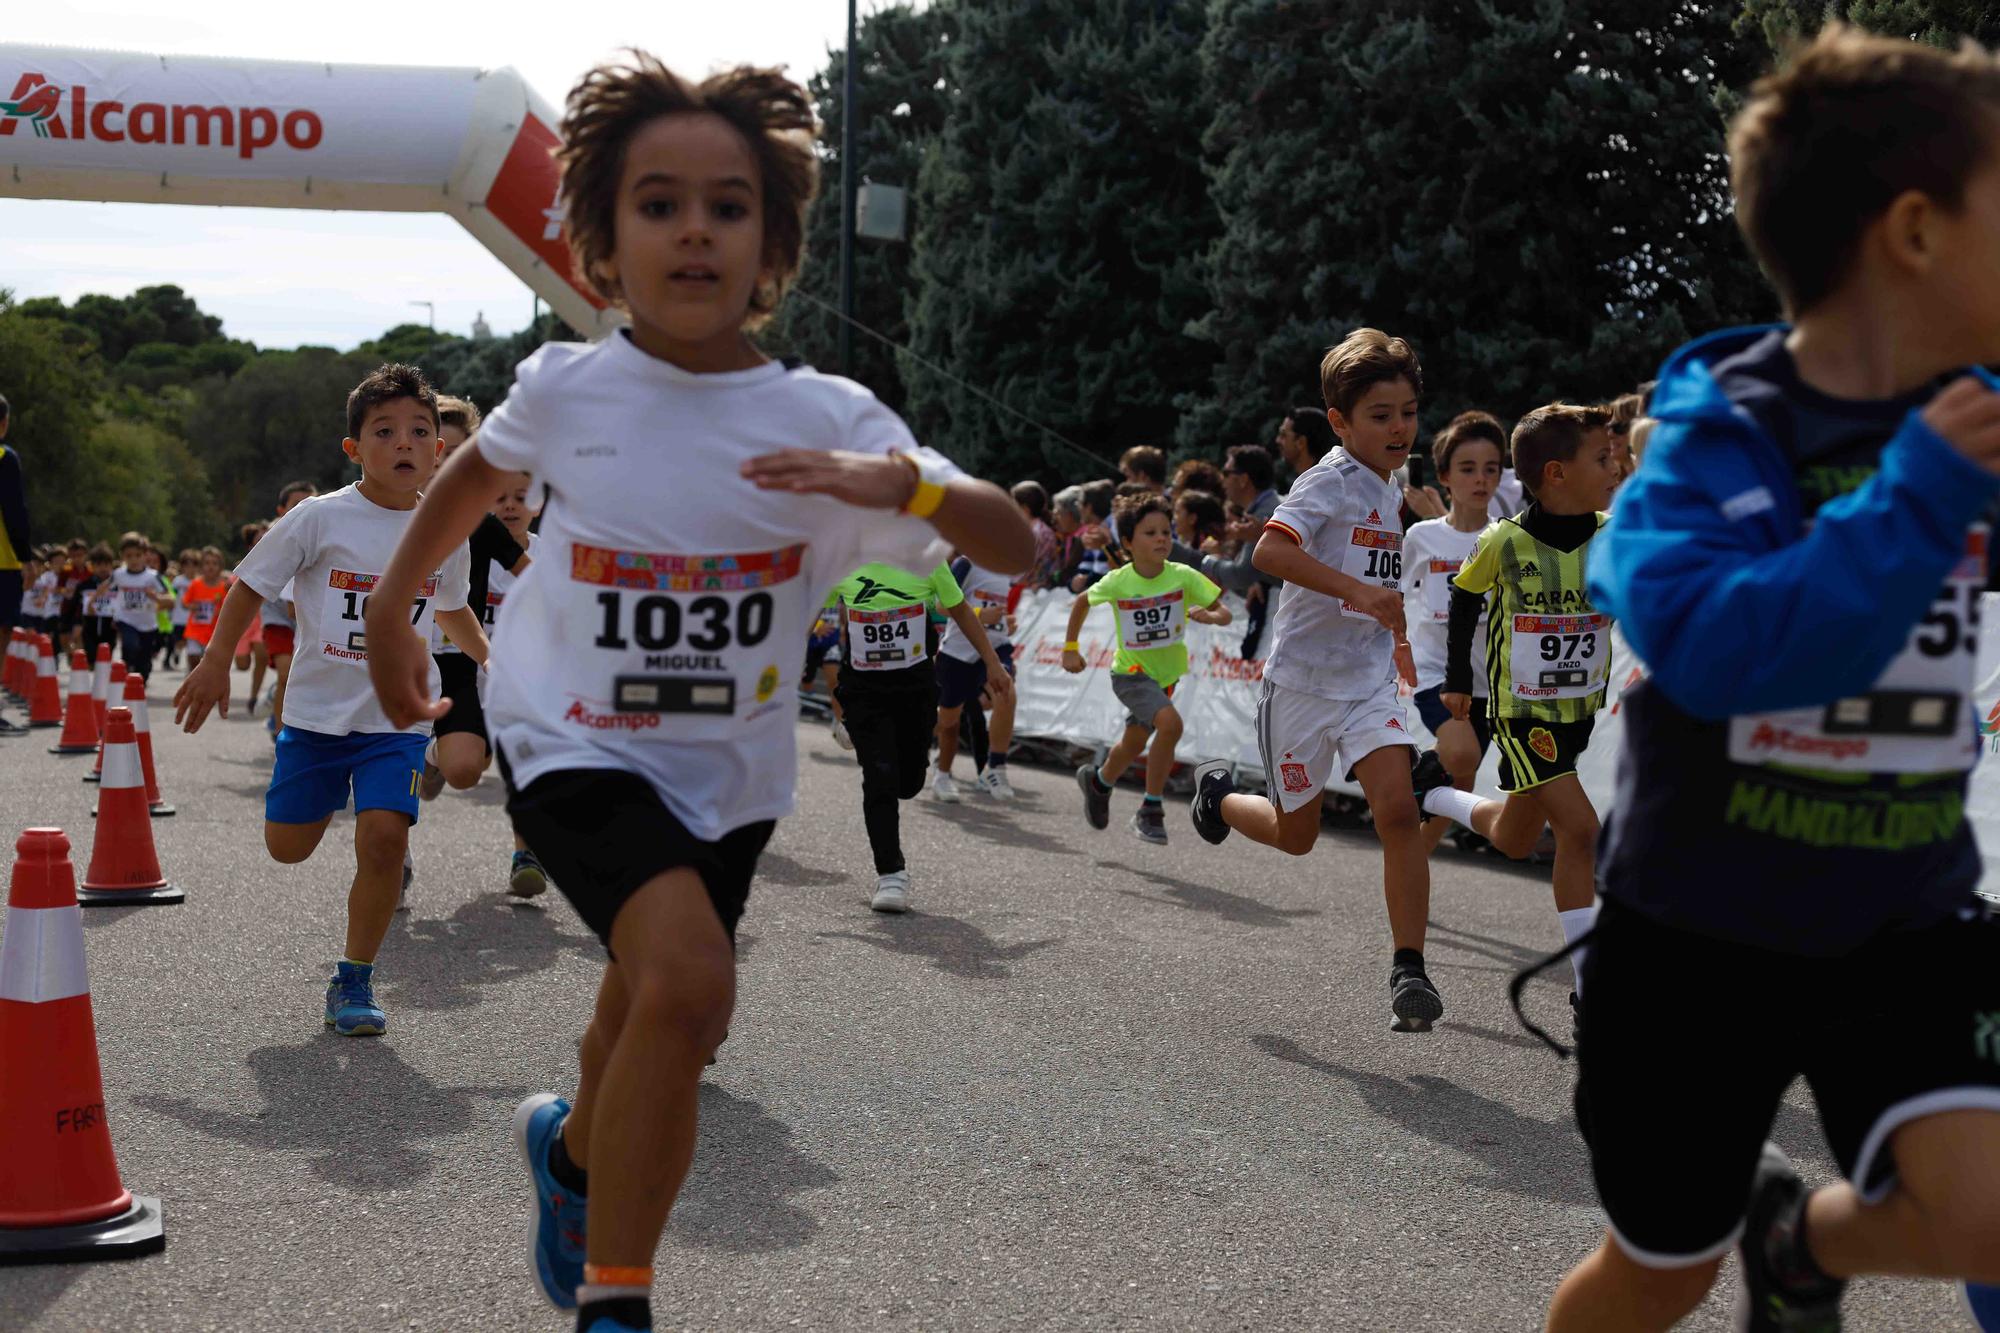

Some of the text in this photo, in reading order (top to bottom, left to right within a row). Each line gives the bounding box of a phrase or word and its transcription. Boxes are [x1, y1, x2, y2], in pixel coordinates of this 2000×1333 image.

[0, 72, 323, 158] Alcampo
[1382, 581, 1398, 589] HUGO
[594, 592, 774, 651] 1030
[1133, 605, 1171, 626] 997
[863, 621, 910, 643] 984
[1540, 633, 1596, 662] 973
[645, 655, 727, 671] MIGUEL
[1557, 661, 1581, 669] ENZO
[1517, 684, 1558, 697] Alcampo
